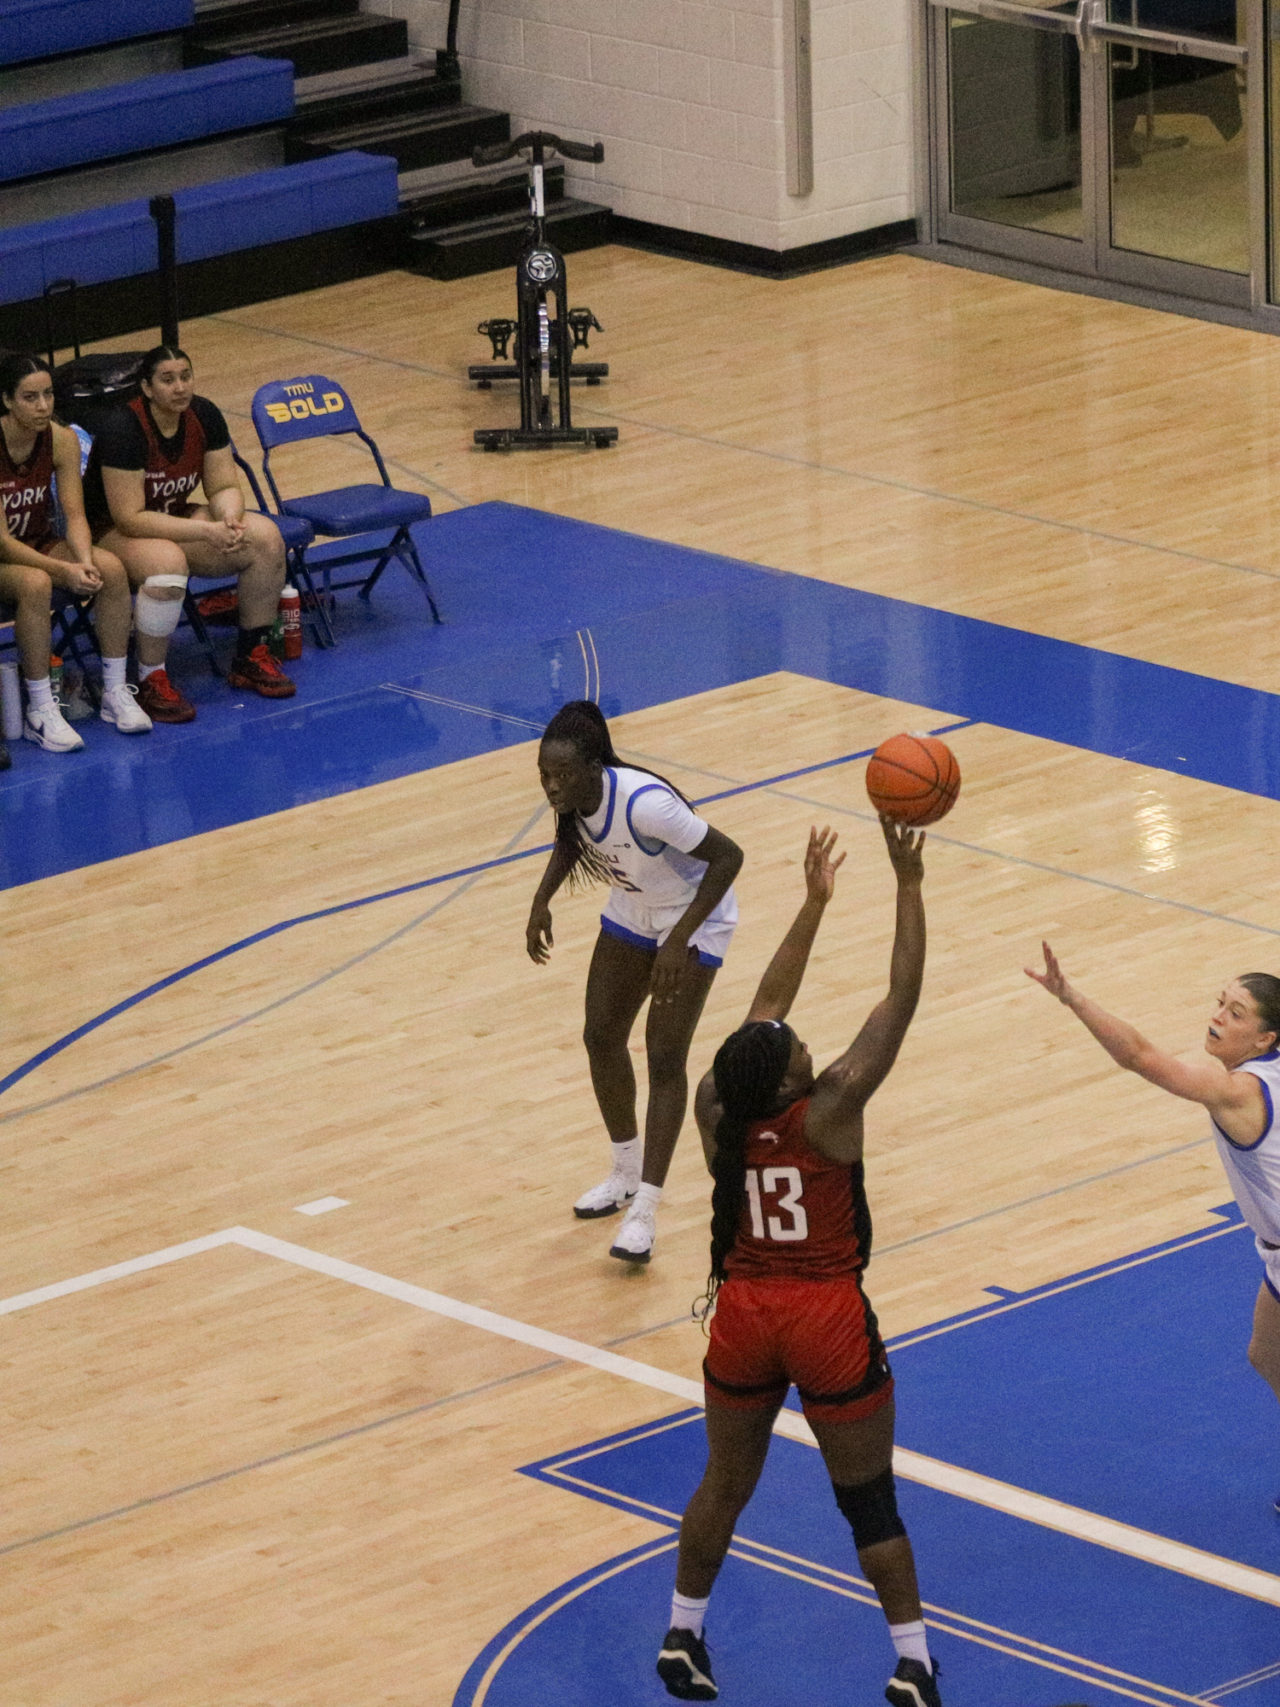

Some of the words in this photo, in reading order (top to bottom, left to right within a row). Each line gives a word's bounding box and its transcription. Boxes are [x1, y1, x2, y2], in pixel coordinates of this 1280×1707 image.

[283, 383, 314, 397] TMU
[265, 392, 344, 424] BOLD
[2, 485, 47, 510] YORK
[152, 472, 197, 498] YORK
[9, 511, 31, 537] 21
[745, 1166, 808, 1241] 13
